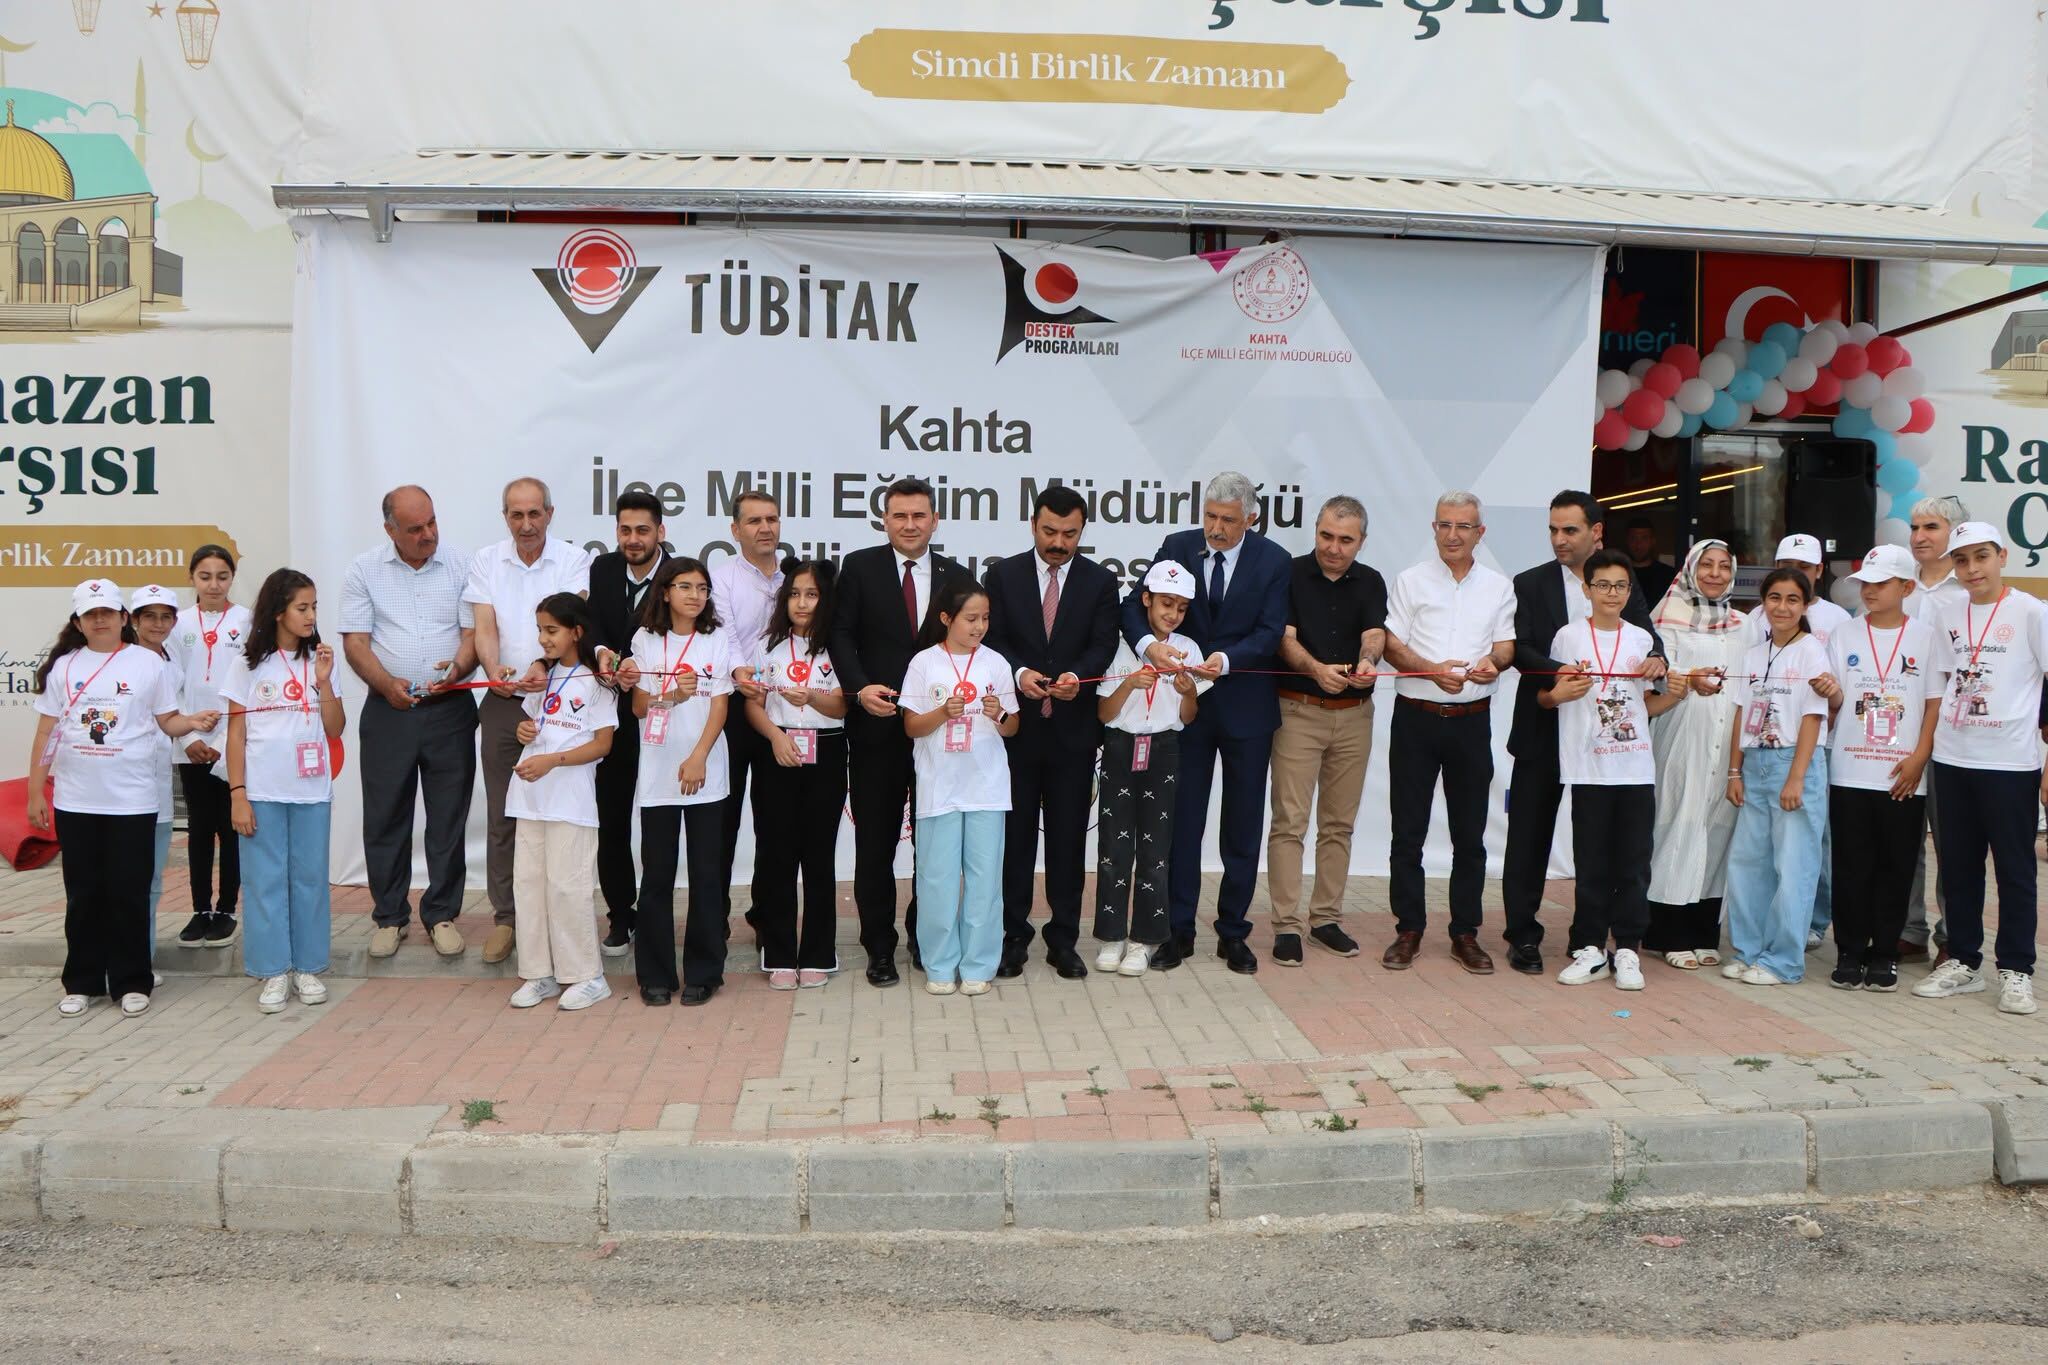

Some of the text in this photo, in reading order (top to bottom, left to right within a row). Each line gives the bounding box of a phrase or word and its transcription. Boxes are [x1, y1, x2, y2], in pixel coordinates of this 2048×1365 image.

[911, 49, 1287, 89] Şimdi Birlik Zamanı
[685, 259, 919, 342] TÜBİTAK
[1026, 323, 1075, 338] DESTEK
[1250, 334, 1288, 345] KAHTA
[1025, 340, 1119, 355] PROGRAMLARI
[1181, 348, 1352, 363] İLÇE MİLLİ EĞİTİM MÜDÜRLÜĞÜ
[0, 374, 215, 424] azan
[880, 405, 1032, 454] Kahta
[834, 473, 999, 532] Eğim
[1020, 477, 1303, 537] Müdürlğü
[62, 542, 184, 567] Zamanı
